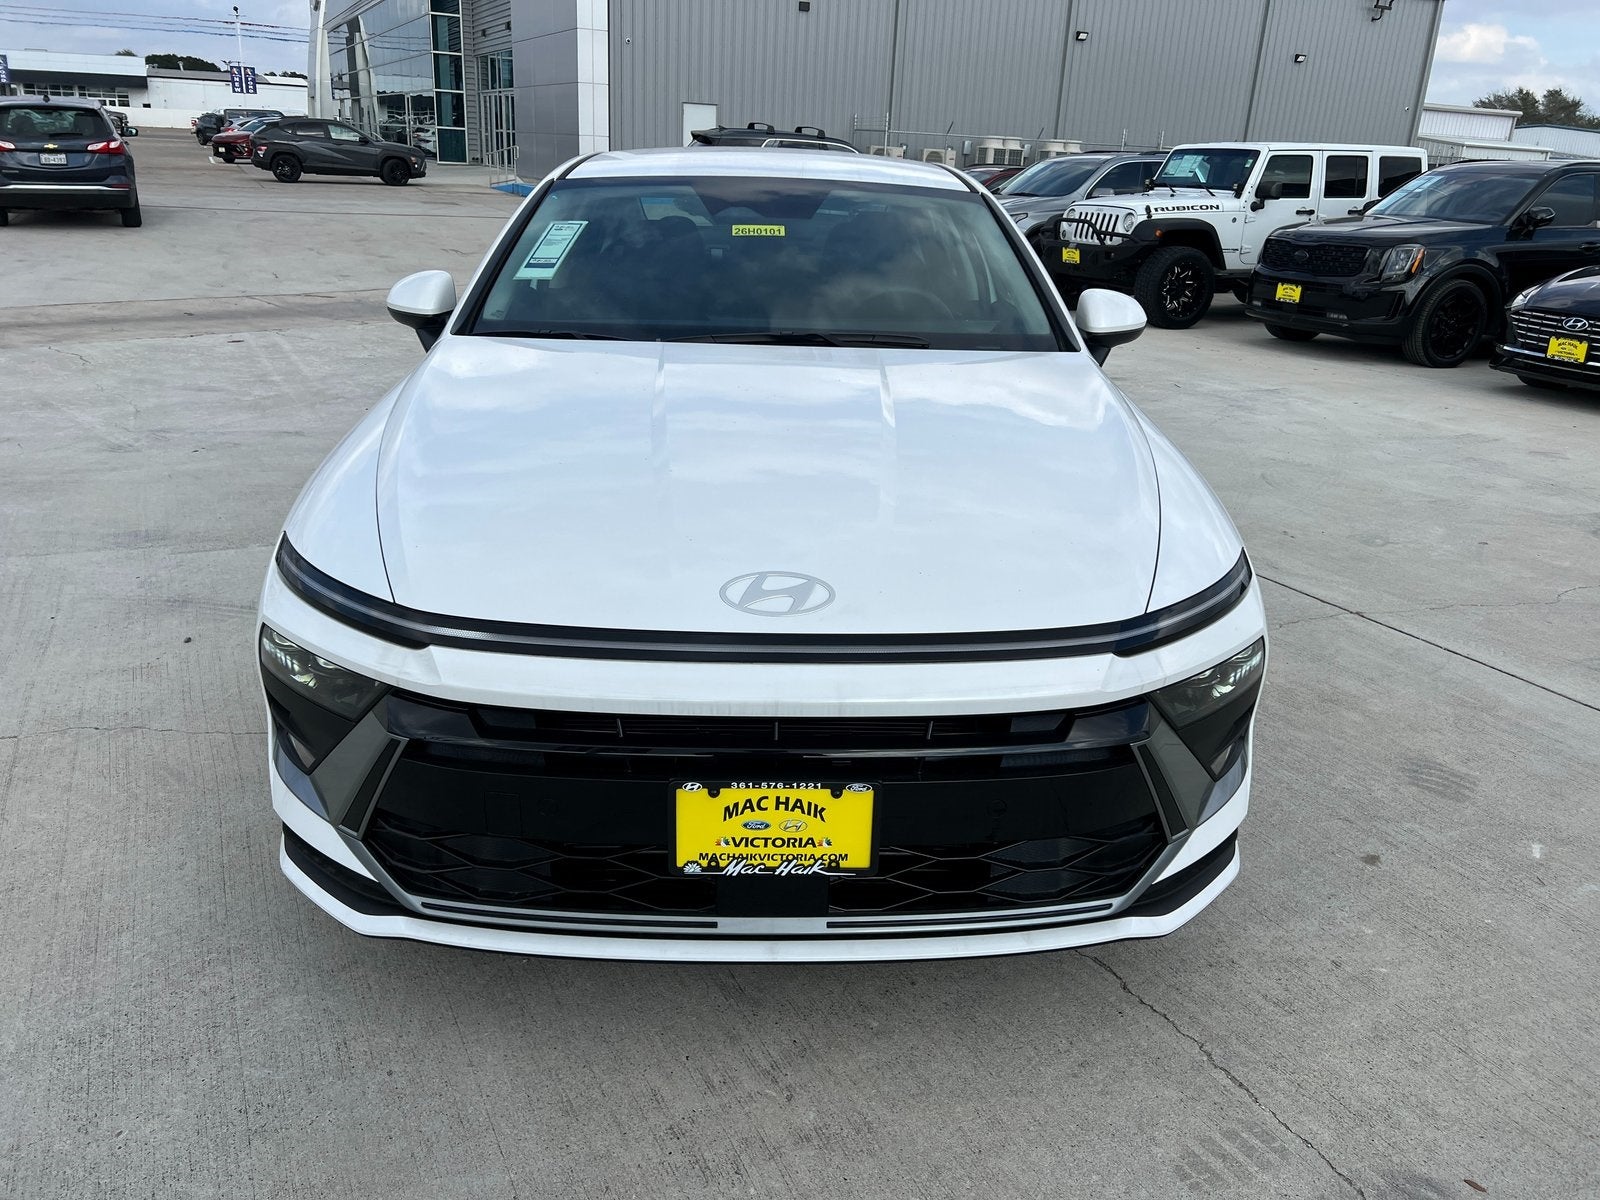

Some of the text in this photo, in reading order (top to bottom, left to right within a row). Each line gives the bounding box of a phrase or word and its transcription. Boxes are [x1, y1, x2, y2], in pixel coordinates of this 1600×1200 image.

[1153, 204, 1220, 212] RUBICON
[734, 227, 782, 235] 26H0101
[730, 782, 822, 790] 361-576-1221
[848, 783, 870, 792] Ford
[722, 795, 826, 823] MAC HAIK
[745, 820, 768, 830] Ford
[730, 836, 817, 848] VICTORIA
[723, 859, 828, 876] Mac Haik
